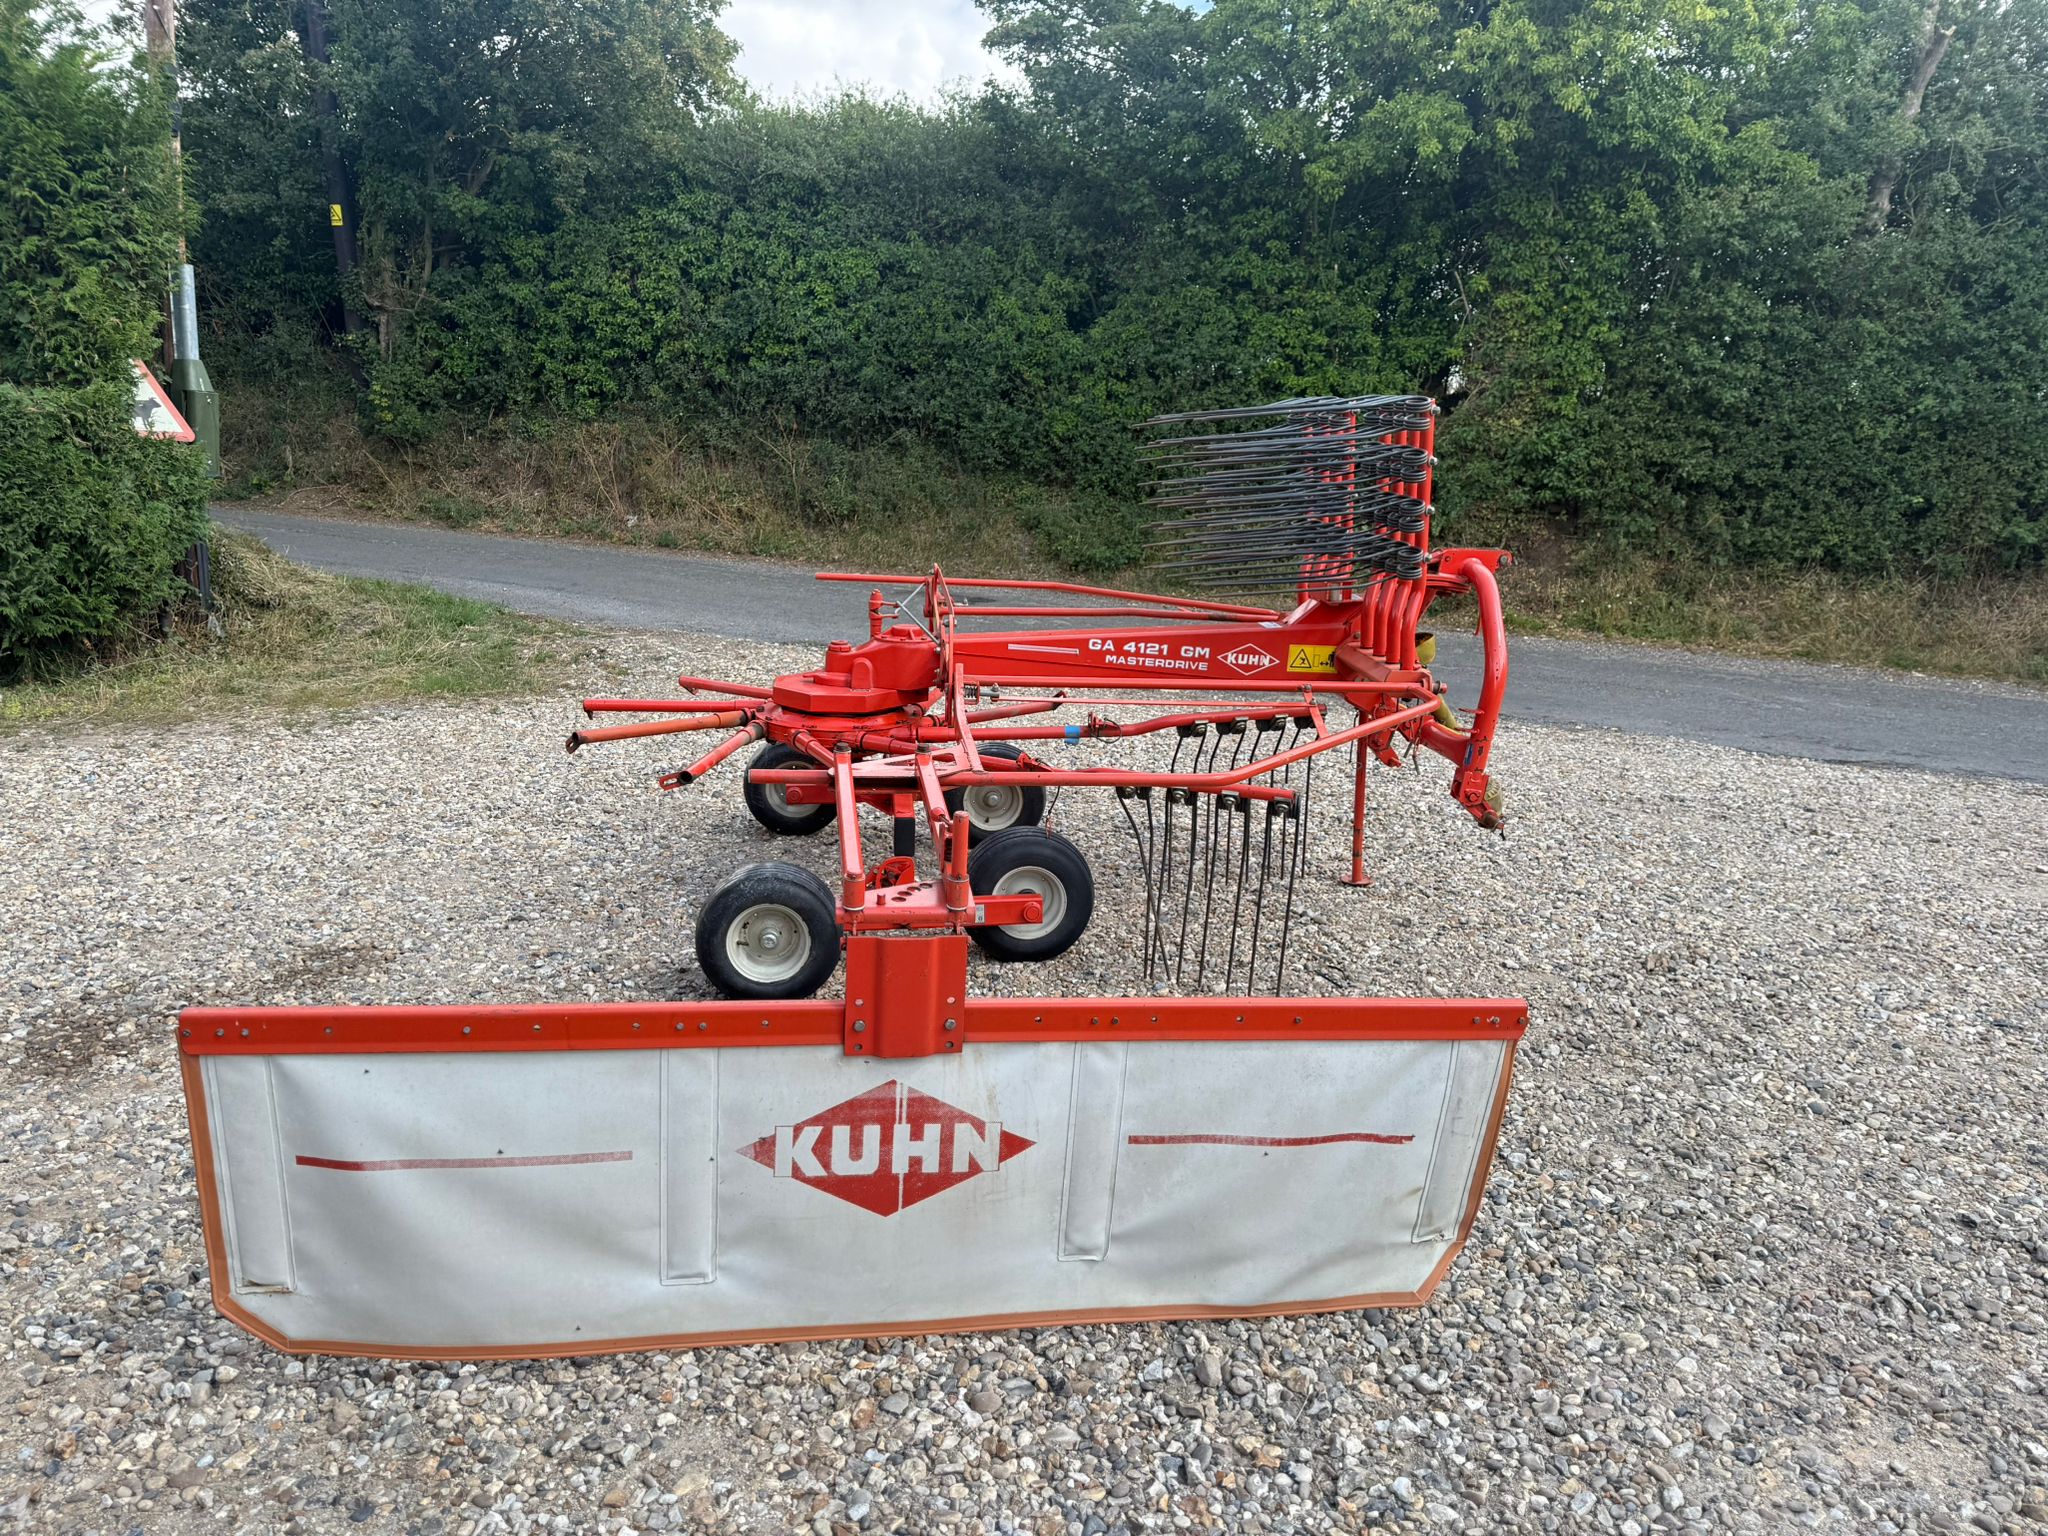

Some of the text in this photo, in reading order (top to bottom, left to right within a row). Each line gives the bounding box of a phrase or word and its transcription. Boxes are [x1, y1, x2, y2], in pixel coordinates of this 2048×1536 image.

[1088, 638, 1210, 658] GA 4121 GM
[1105, 655, 1209, 671] MASTERDRIVE
[1226, 652, 1271, 666] KUHN
[773, 1121, 1003, 1178] KUHN
